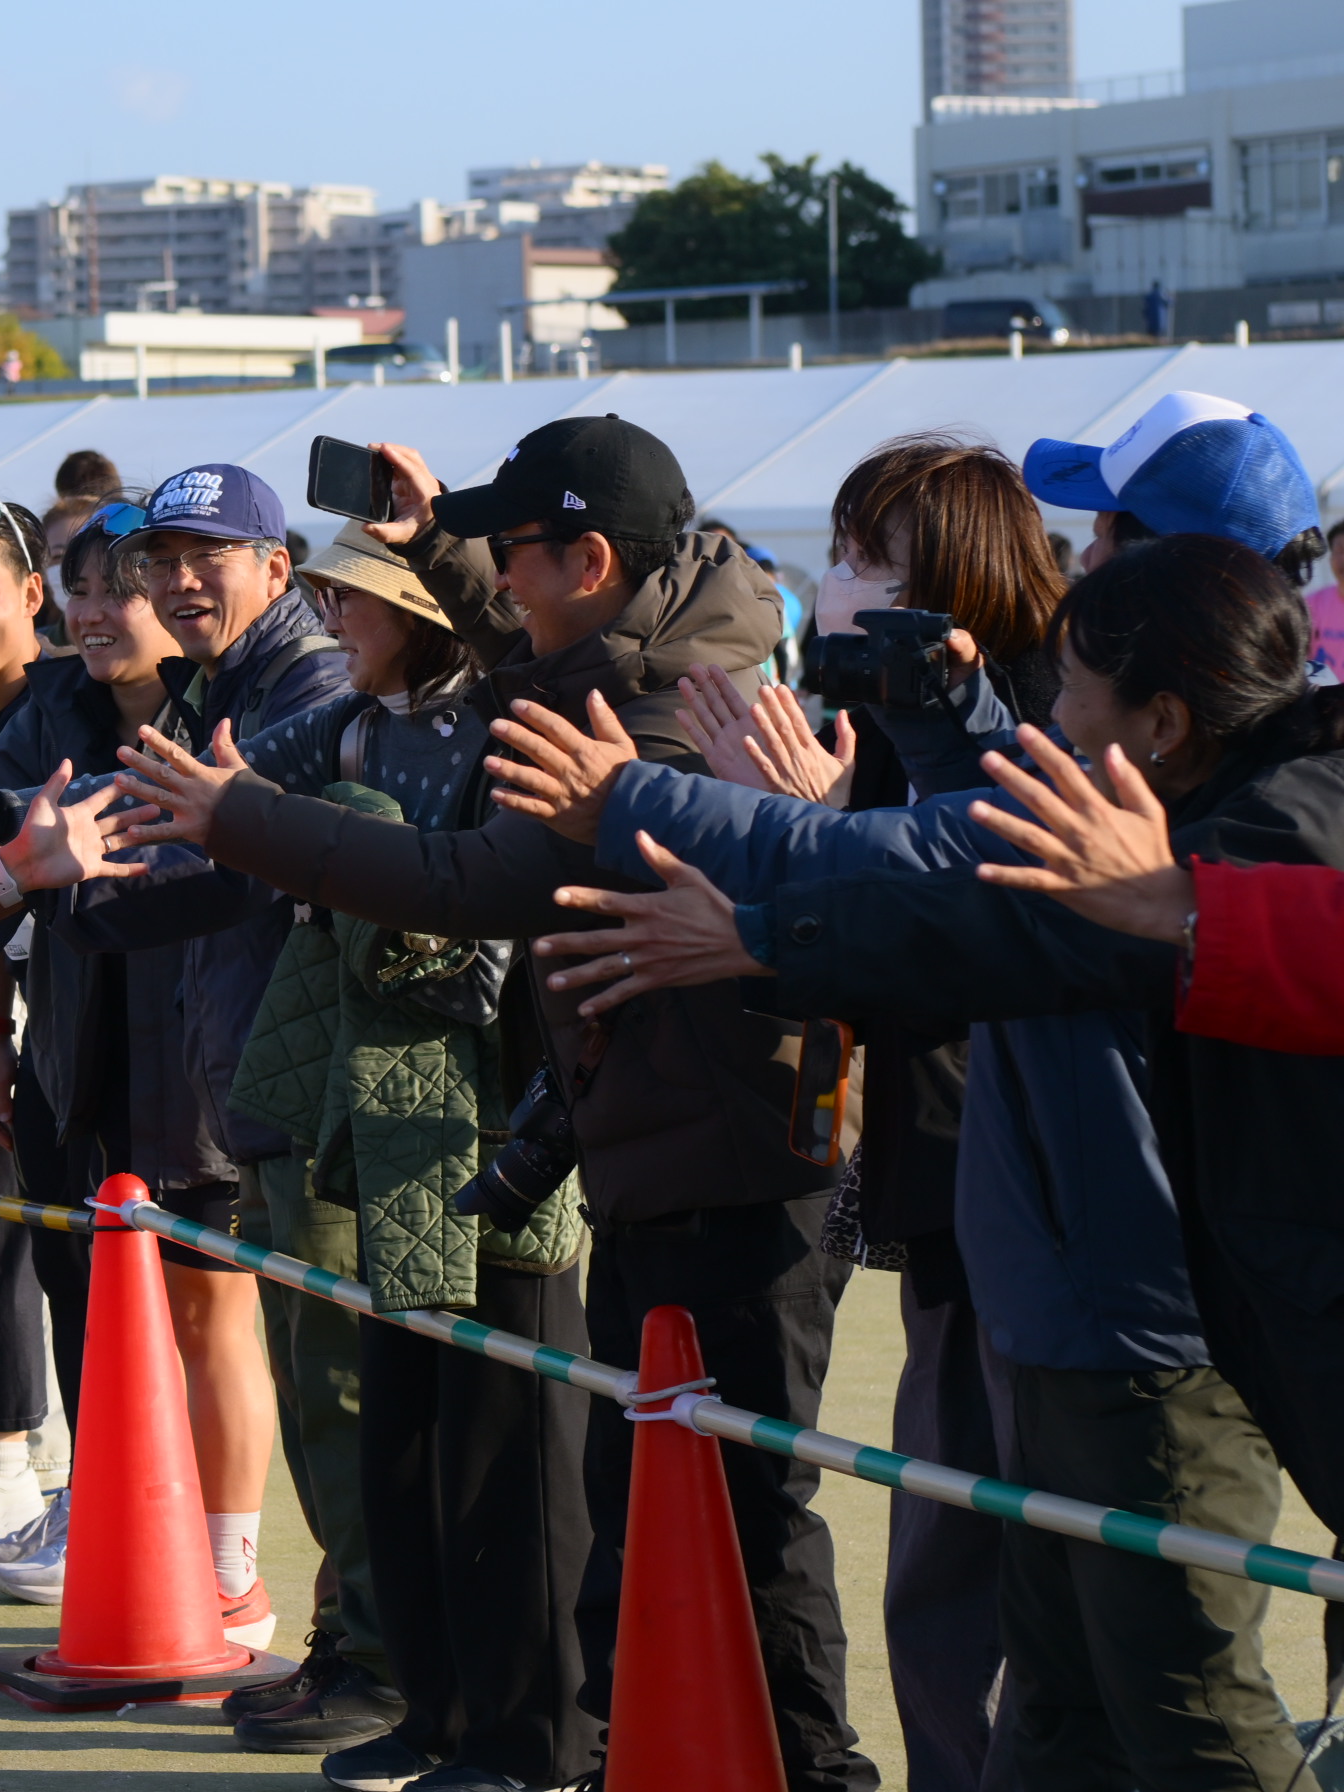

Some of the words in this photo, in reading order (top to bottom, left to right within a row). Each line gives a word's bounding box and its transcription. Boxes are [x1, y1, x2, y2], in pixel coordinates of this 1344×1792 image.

[162, 473, 187, 494] LE
[183, 472, 223, 490] COQ
[153, 487, 223, 513] SPORTIF
